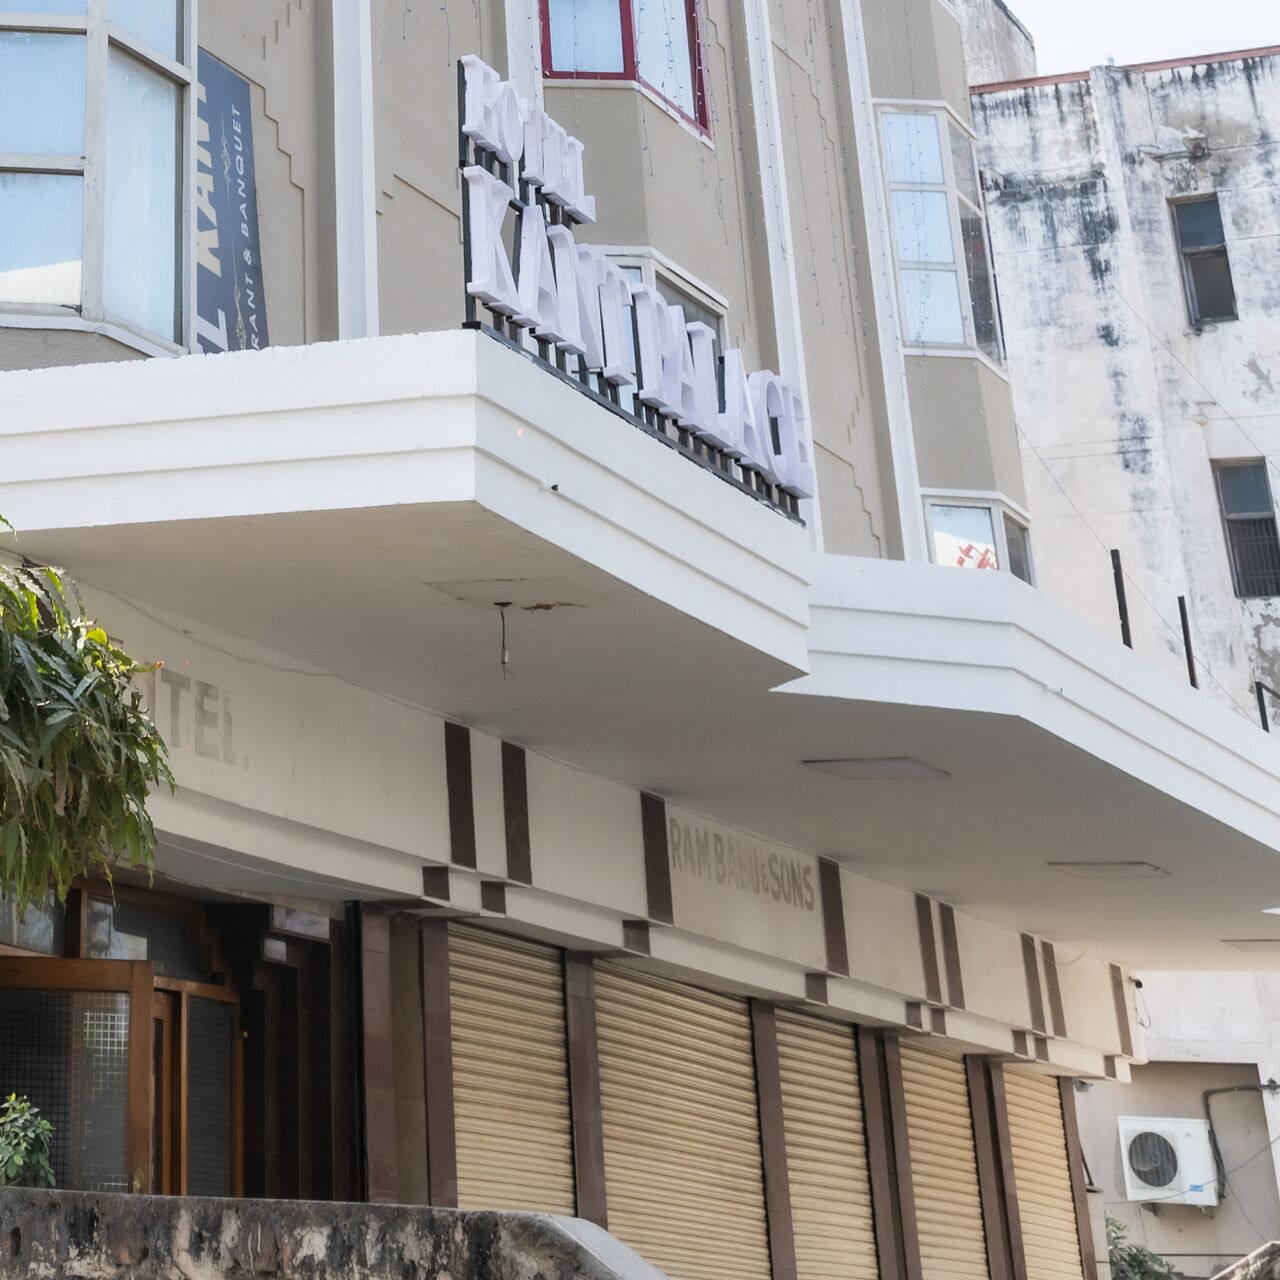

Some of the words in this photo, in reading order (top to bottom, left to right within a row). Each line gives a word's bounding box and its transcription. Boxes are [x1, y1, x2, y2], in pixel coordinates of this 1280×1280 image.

[232, 104, 250, 238] BANQUET
[461, 54, 596, 224] HOTEL
[243, 247, 252, 266] &
[463, 165, 633, 386] KANT
[631, 283, 813, 499] PALACE
[670, 817, 712, 880] RAM
[768, 853, 815, 911] SONS
